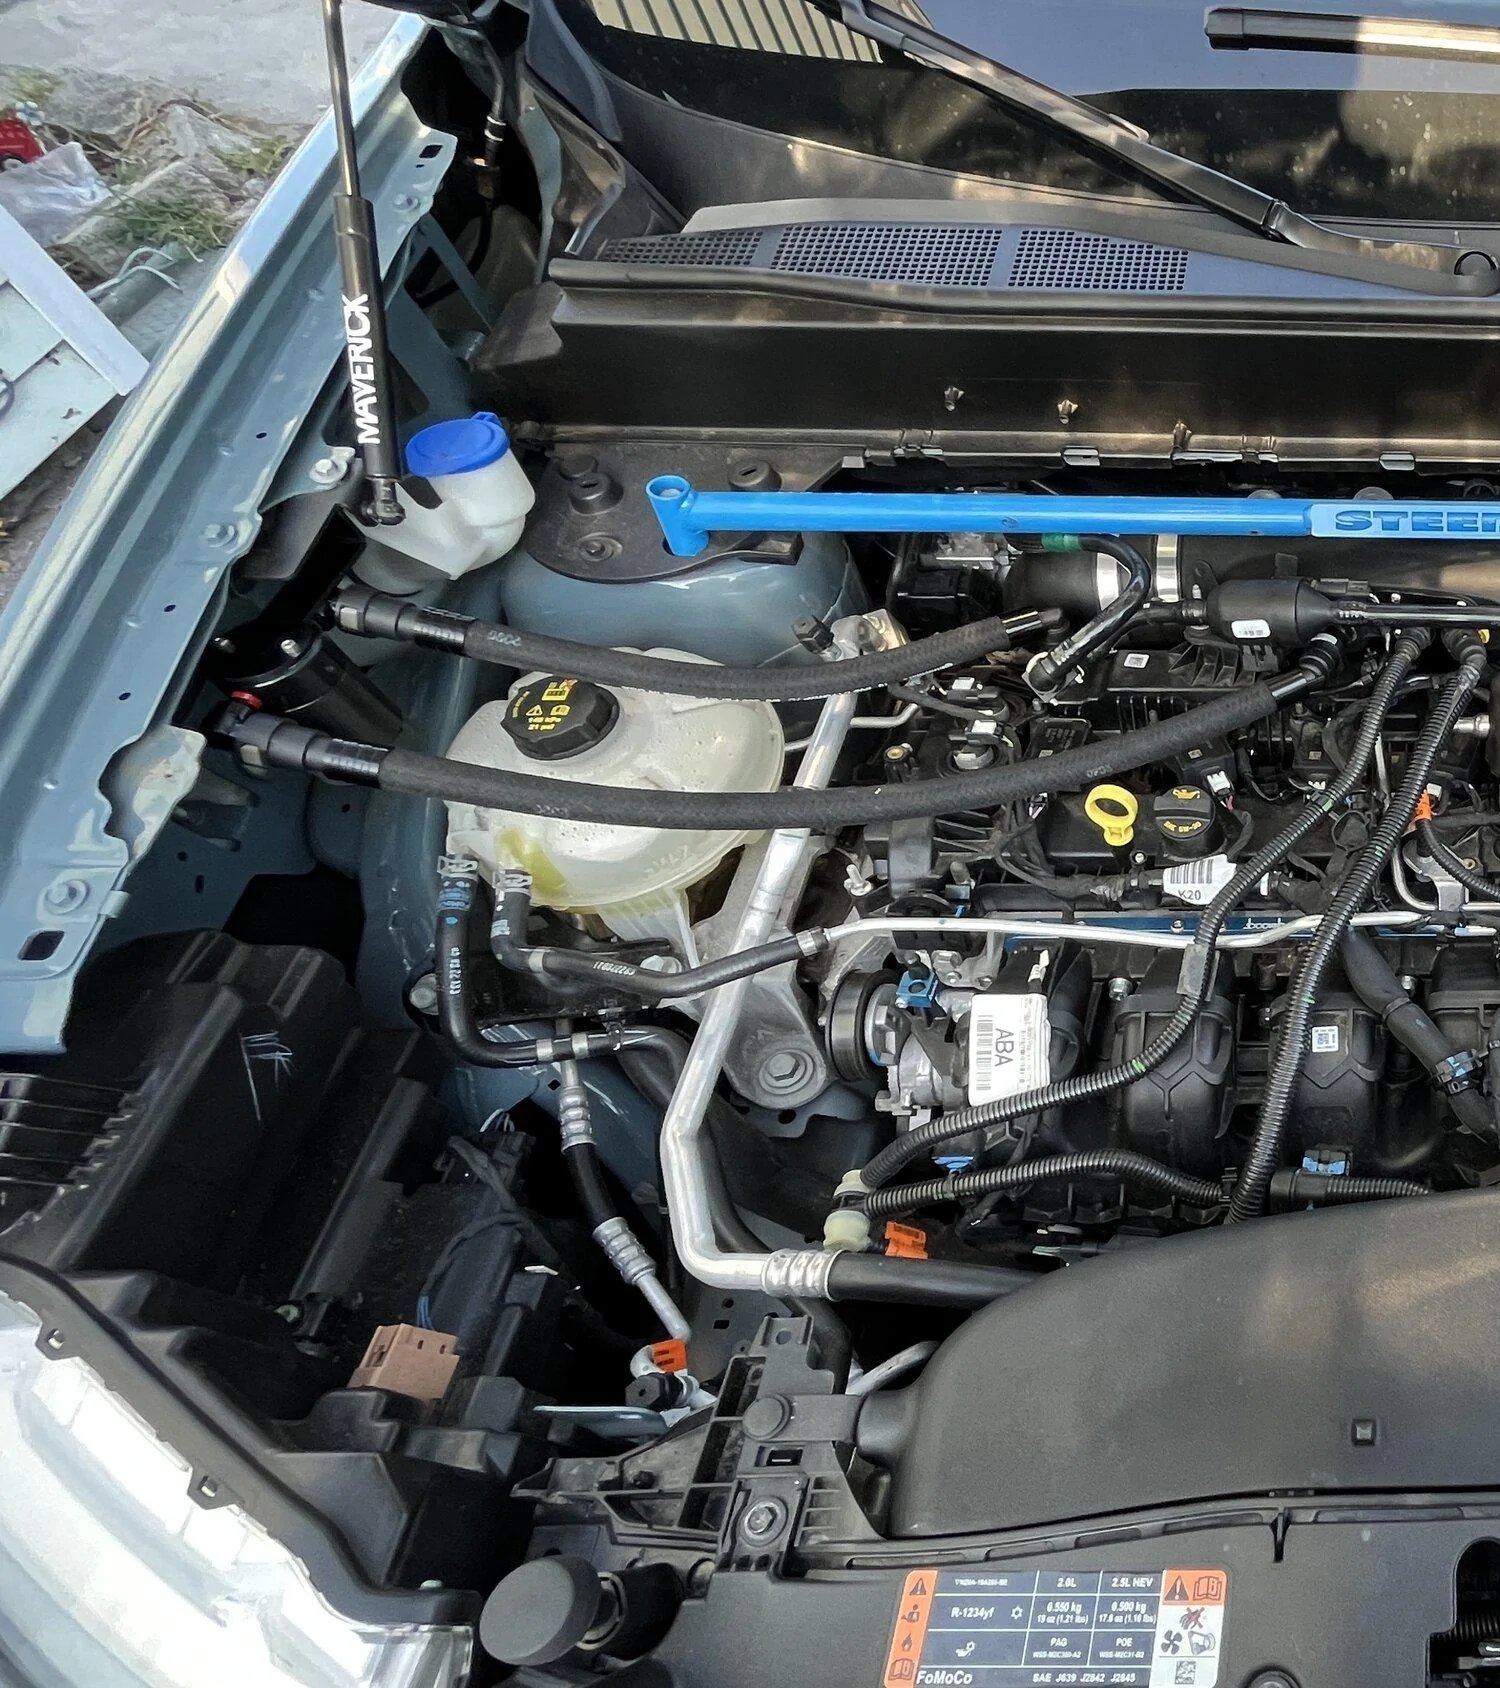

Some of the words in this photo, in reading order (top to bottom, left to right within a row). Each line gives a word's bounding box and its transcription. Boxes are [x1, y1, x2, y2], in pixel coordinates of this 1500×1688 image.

[342, 293, 381, 445] MAVERICK
[1178, 889, 1202, 901] K20
[994, 1027, 1015, 1068] ABA
[1056, 1578, 1077, 1588] 2.0L
[1111, 1578, 1131, 1588] 2.5L
[1132, 1577, 1154, 1588] HEV
[950, 1606, 995, 1621] R-1234yf
[1070, 1602, 1083, 1615] kg
[1135, 1601, 1147, 1615] kg
[1050, 1637, 1068, 1648] PAG
[1115, 1637, 1133, 1648] POE
[916, 1669, 973, 1685] FoMoCo
[1032, 1672, 1052, 1683] SAE
